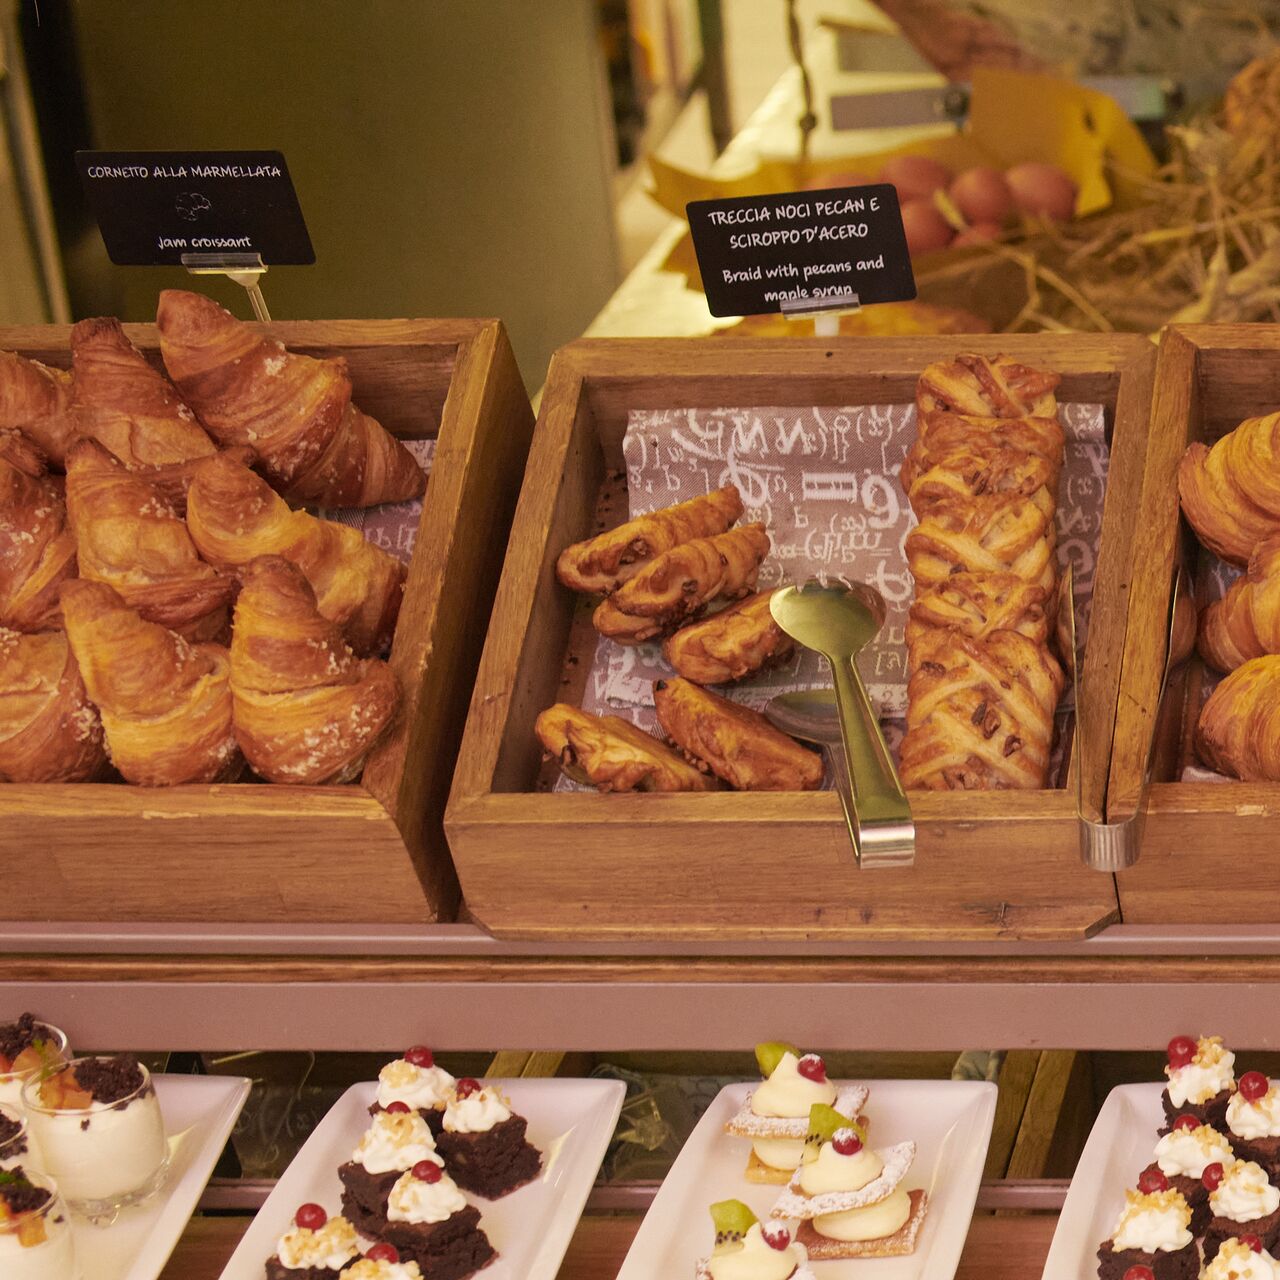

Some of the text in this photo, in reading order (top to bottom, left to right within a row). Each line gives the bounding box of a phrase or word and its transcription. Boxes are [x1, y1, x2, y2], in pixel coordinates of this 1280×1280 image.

[88, 166, 281, 178] CORNETTO ALLA MARMELLATA
[708, 197, 880, 225] TRECCIA NOCI PECAN E
[192, 236, 252, 248] croissant
[730, 223, 868, 249] SCIROPPO D'ACERO
[723, 255, 884, 283] Braid with pecans and
[764, 284, 809, 302] maple
